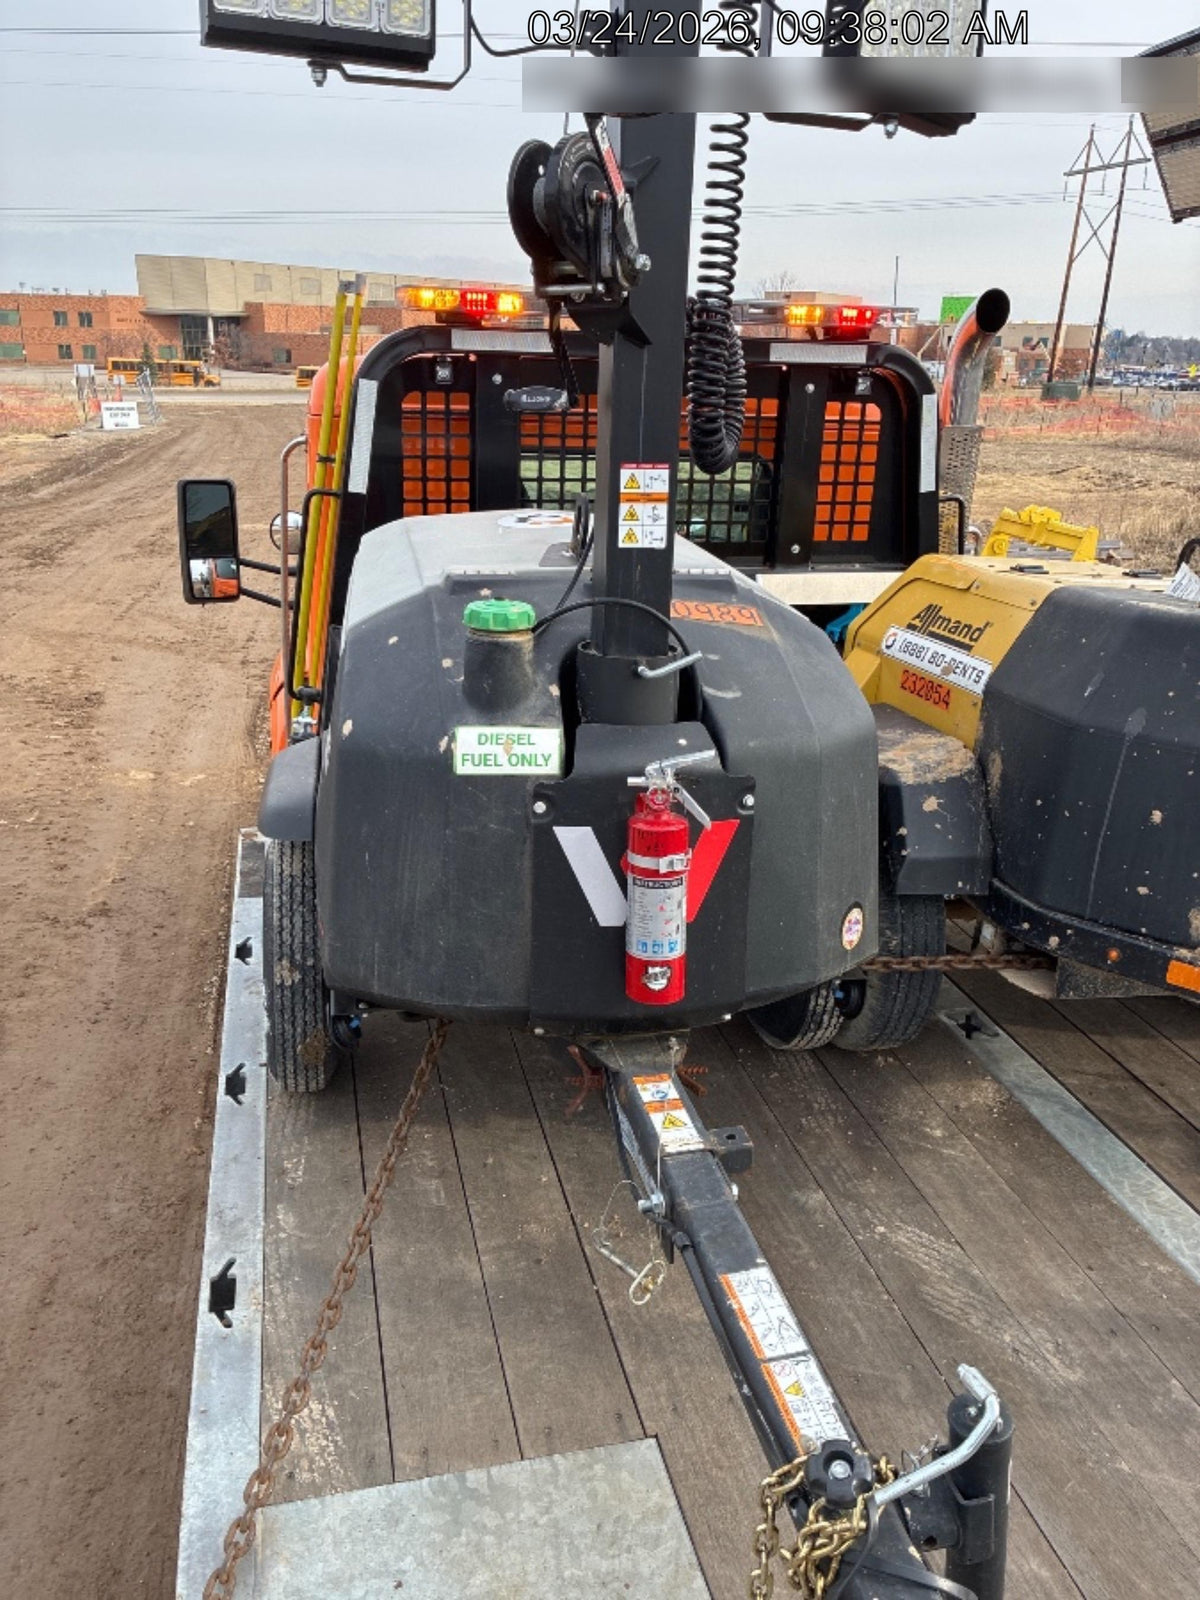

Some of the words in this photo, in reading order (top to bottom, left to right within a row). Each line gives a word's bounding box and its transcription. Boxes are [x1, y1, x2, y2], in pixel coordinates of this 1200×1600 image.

[911, 603, 990, 642] Allmand
[477, 733, 536, 746] DIESEL
[461, 753, 504, 767] FUEL
[507, 753, 552, 767] ONLY
